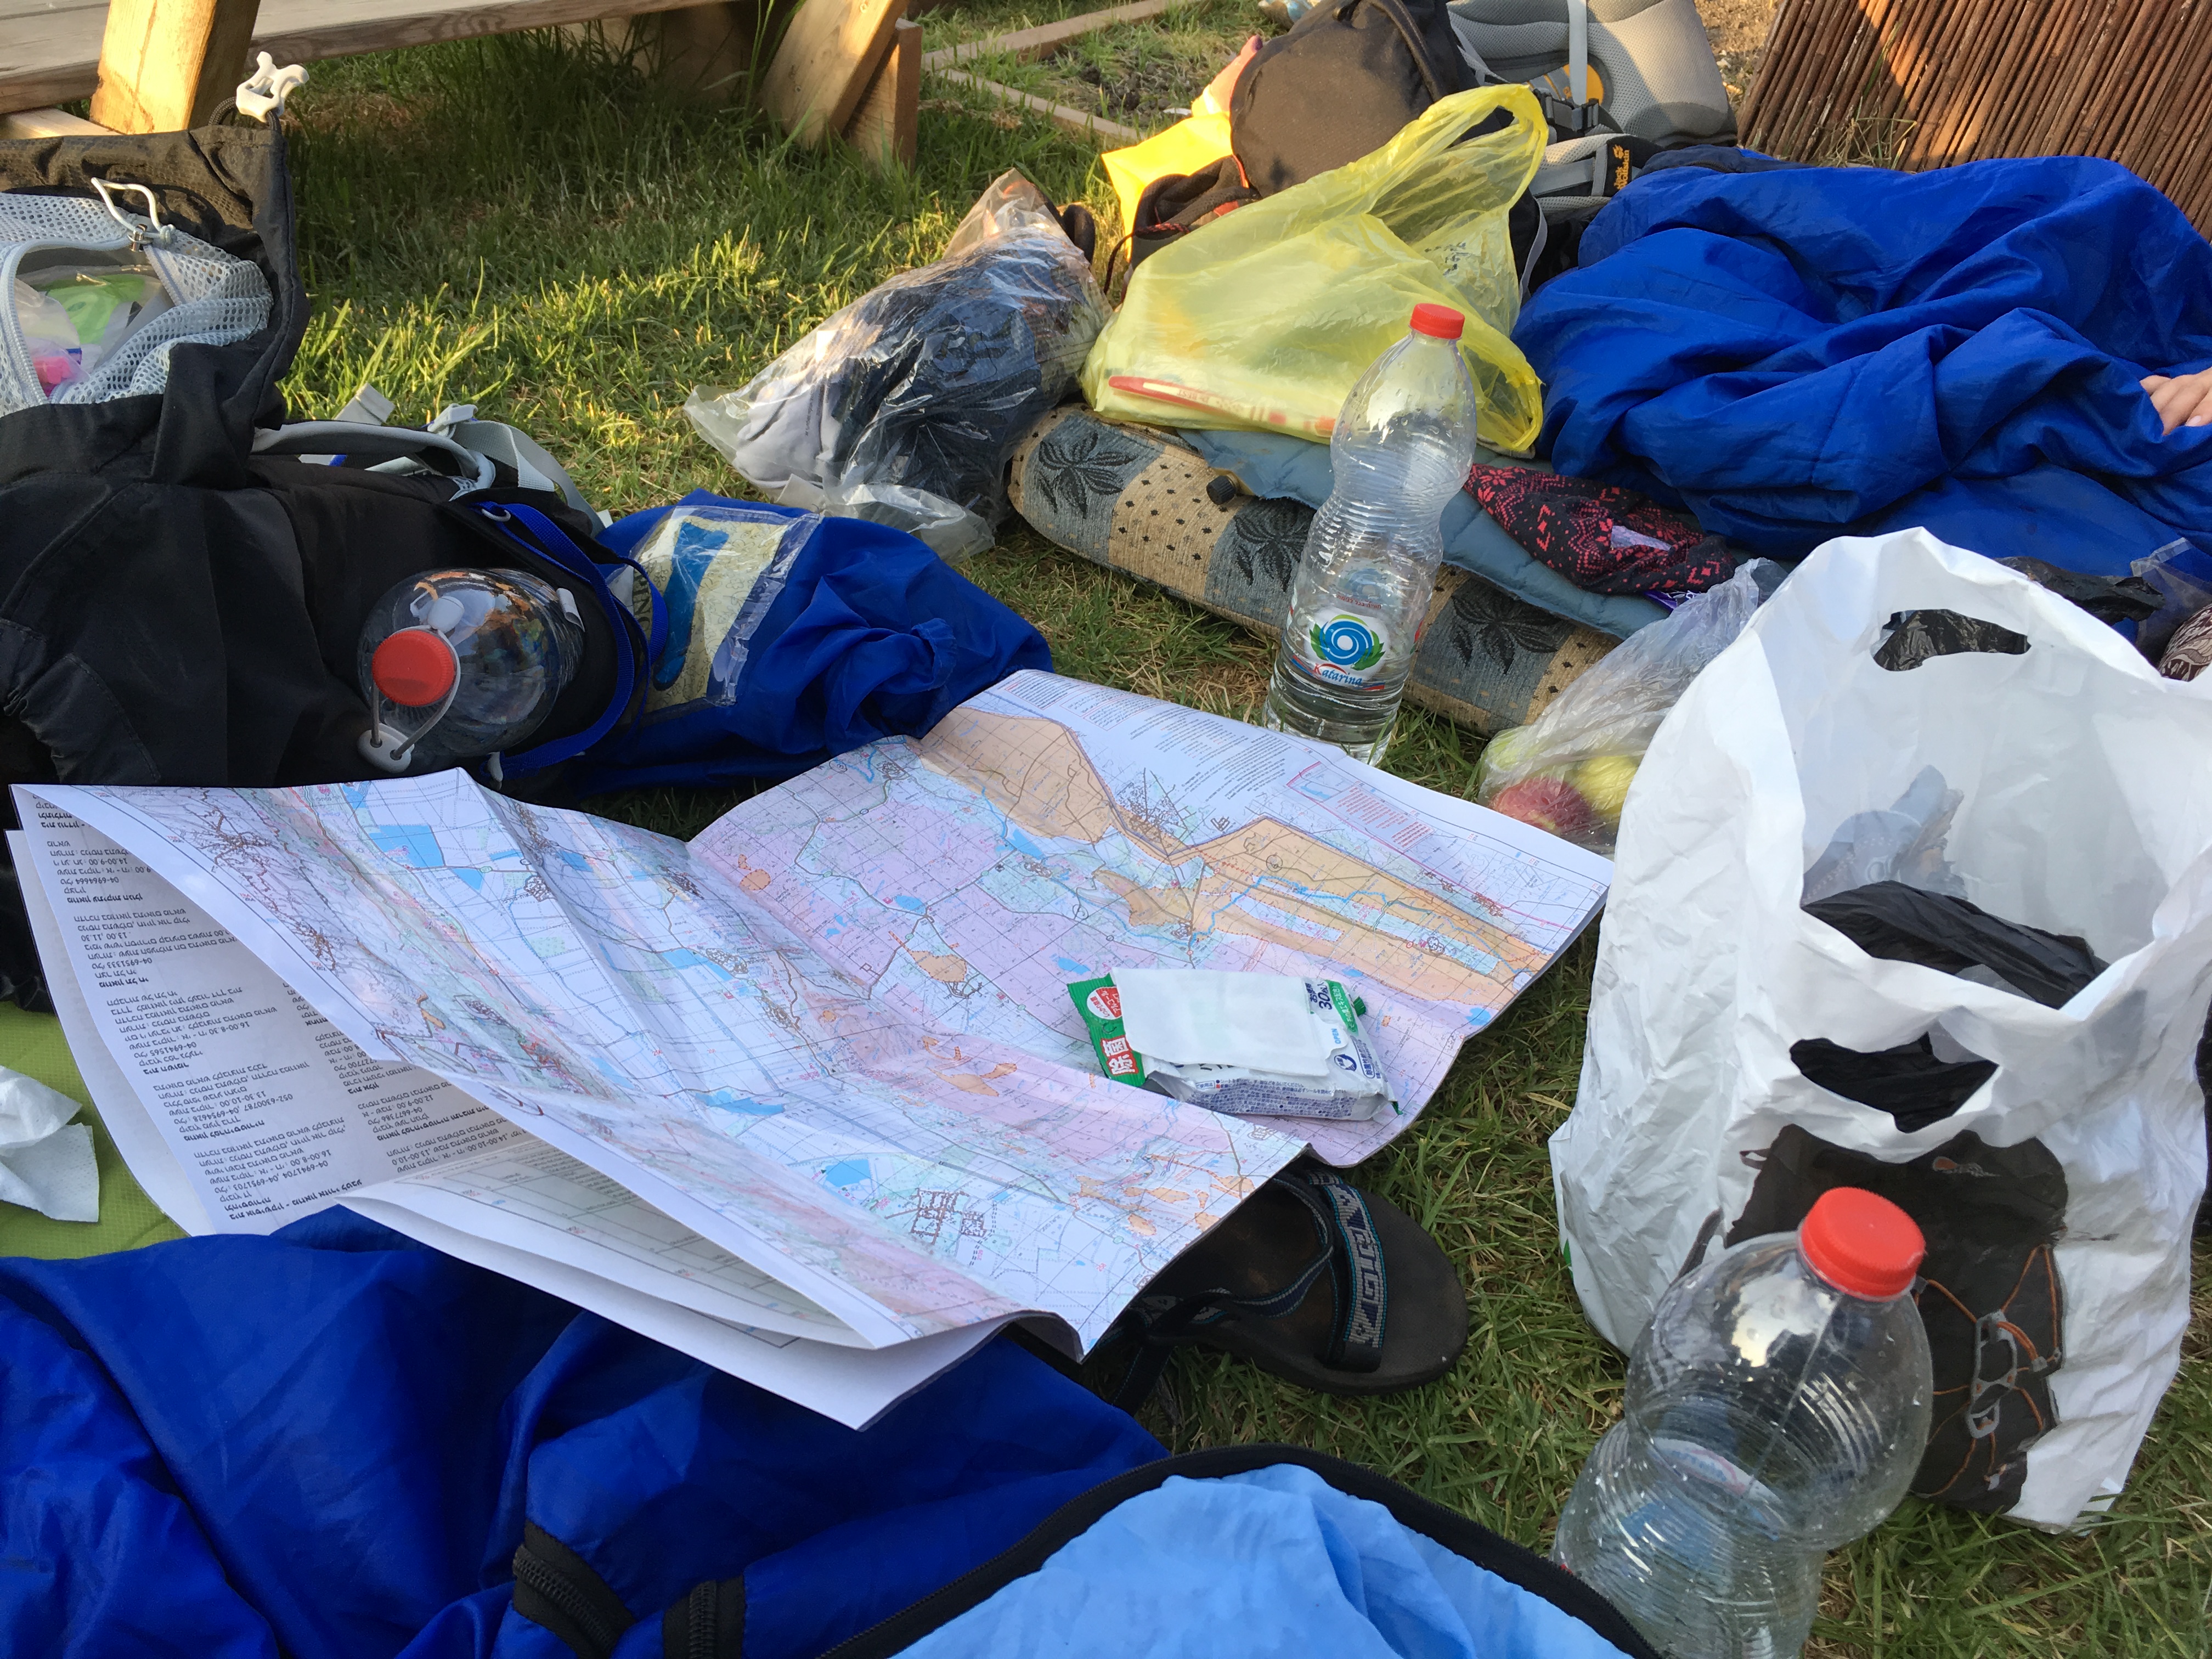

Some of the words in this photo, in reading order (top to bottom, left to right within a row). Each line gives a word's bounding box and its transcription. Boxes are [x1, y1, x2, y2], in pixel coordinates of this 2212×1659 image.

[1614, 166, 1623, 189] Jack
[1313, 663, 1363, 686] Katarina
[57, 820, 81, 828] גורדון
[88, 857, 128, 866] 14.00-9.00
[75, 876, 119, 885] 04-6964664
[64, 885, 87, 894] קצרין
[66, 895, 92, 904] מוזאון
[92, 894, 122, 902] עתיקות
[122, 892, 143, 901] הגולן
[100, 911, 132, 921] במוזאון
[132, 910, 162, 918] בתיאום
[136, 918, 157, 927] חזיון
[105, 932, 127, 940] 13.00
[123, 938, 157, 947] הסיורים
[159, 934, 187, 944] קבועים
[187, 931, 213, 940] בשעות
[119, 949, 139, 957] שעות
[140, 945, 173, 955] הפעילות
[187, 939, 217, 949] בתיאום
[106, 957, 153, 969] 04-6951333
[98, 978, 125, 988] מוזאון
[106, 996, 140, 1006] הקברות
[110, 1005, 133, 1015] בדרך
[136, 999, 168, 1012] למוזאון
[168, 996, 186, 1006] ניתן
[187, 994, 210, 1003] לעבור
[211, 989, 227, 998] דרך
[227, 986, 242, 995] בית
[115, 1014, 144, 1025] הדרכה
[144, 1007, 177, 1019] במוזאון
[177, 1002, 209, 1013] בתיאום
[209, 997, 234, 1007] מראש
[151, 1017, 177, 1027] כניסה
[177, 1011, 211, 1022] בתשלום
[147, 1028, 171, 1037] וערבי
[188, 1017, 222, 1030] לקבוצות
[222, 1011, 253, 1022] בתיאום
[253, 1006, 278, 1016] מראש
[128, 1041, 151, 1050] שעות
[208, 1021, 250, 1035] 16.00-8.30
[1331, 1028, 1341, 1045] OPEN
[149, 1041, 197, 1057] 04-6941565
[319, 1040, 342, 1049] כניסה
[324, 1047, 341, 1057] שבת
[138, 1057, 163, 1066] קיבוץ
[179, 1050, 203, 1059] גלעדי
[1102, 1037, 1135, 1075] 除菌
[142, 1066, 159, 1075] בית
[160, 1062, 189, 1072] השומר
[153, 1081, 185, 1091] בתיאום
[185, 1076, 211, 1086] מראש
[212, 1067, 246, 1081] לקבוצות
[246, 1063, 268, 1072] בלבד
[338, 1069, 360, 1079] קיבוץ
[359, 1064, 383, 1074] גינוסר
[189, 1084, 215, 1094] כניסה
[251, 1069, 279, 1080] הדרכה
[278, 1061, 310, 1074] במוזאון
[342, 1077, 363, 1087] מרכז
[362, 1073, 386, 1082] חינוכי
[347, 1086, 363, 1094] בית
[362, 1081, 380, 1091] אלון
[163, 1099, 183, 1108] כולל
[183, 1097, 201, 1105] סופי
[202, 1091, 223, 1102] שבוע
[223, 1086, 247, 1097] וחגים
[168, 1107, 190, 1116] שעות
[219, 1090, 267, 1108] 13.30-10.00
[244, 1093, 293, 1111] 052-6300787
[357, 1099, 380, 1110] כניסה
[380, 1092, 410, 1104] בתשלום
[409, 1084, 441, 1096] ובתיאום
[396, 1094, 433, 1109] 12.00-9.00
[372, 1122, 394, 1133] קיבוץ
[394, 1119, 410, 1127] שער
[409, 1112, 430, 1123] הגולן
[381, 1106, 422, 1122] 04-6677386
[179, 1123, 202, 1133] קיבוץ
[202, 1119, 221, 1129] מעין
[221, 1115, 241, 1126] ברוך
[183, 1131, 209, 1142] מוזאון
[209, 1119, 265, 1138] לפרהיסטוריה
[376, 1129, 400, 1141] מוזאון
[400, 1116, 450, 1135] לפרהיסטוריה
[450, 1108, 476, 1120] ותרבות
[193, 1149, 221, 1158] הדרכה
[221, 1141, 253, 1154] במוזאון
[253, 1133, 285, 1147] בתיאום
[285, 1126, 311, 1137] מראש
[312, 1116, 345, 1131] לקבוצות
[414, 1138, 437, 1149] כניסה
[436, 1129, 466, 1142] בתשלום
[466, 1120, 496, 1133] ובתיאום
[433, 1143, 450, 1153] שבת
[449, 1135, 477, 1147] בתיאום
[477, 1128, 499, 1138] מראש
[229, 1152, 253, 1162] כניסה
[290, 1135, 311, 1146] חזיון
[311, 1132, 327, 1140] אור
[204, 1167, 224, 1176] שישי
[224, 1163, 246, 1172] ושבת
[246, 1155, 278, 1168] בתיאום
[279, 1147, 304, 1159] מראש
[210, 1175, 230, 1184] שעות
[290, 1149, 331, 1167] 16.00-8.00
[282, 1160, 329, 1178] 04-6941704
[397, 1162, 416, 1173] שעות
[219, 1192, 242, 1203] קיבוץ
[242, 1189, 252, 1198] דן
[224, 1197, 272, 1211] ולהיסטוריה
[228, 1211, 245, 1220] בית
[245, 1202, 285, 1217] אוסישקין
[291, 1192, 318, 1206] מוזאון
[317, 1187, 340, 1198] אזורי
[341, 1178, 363, 1191] לטבע
